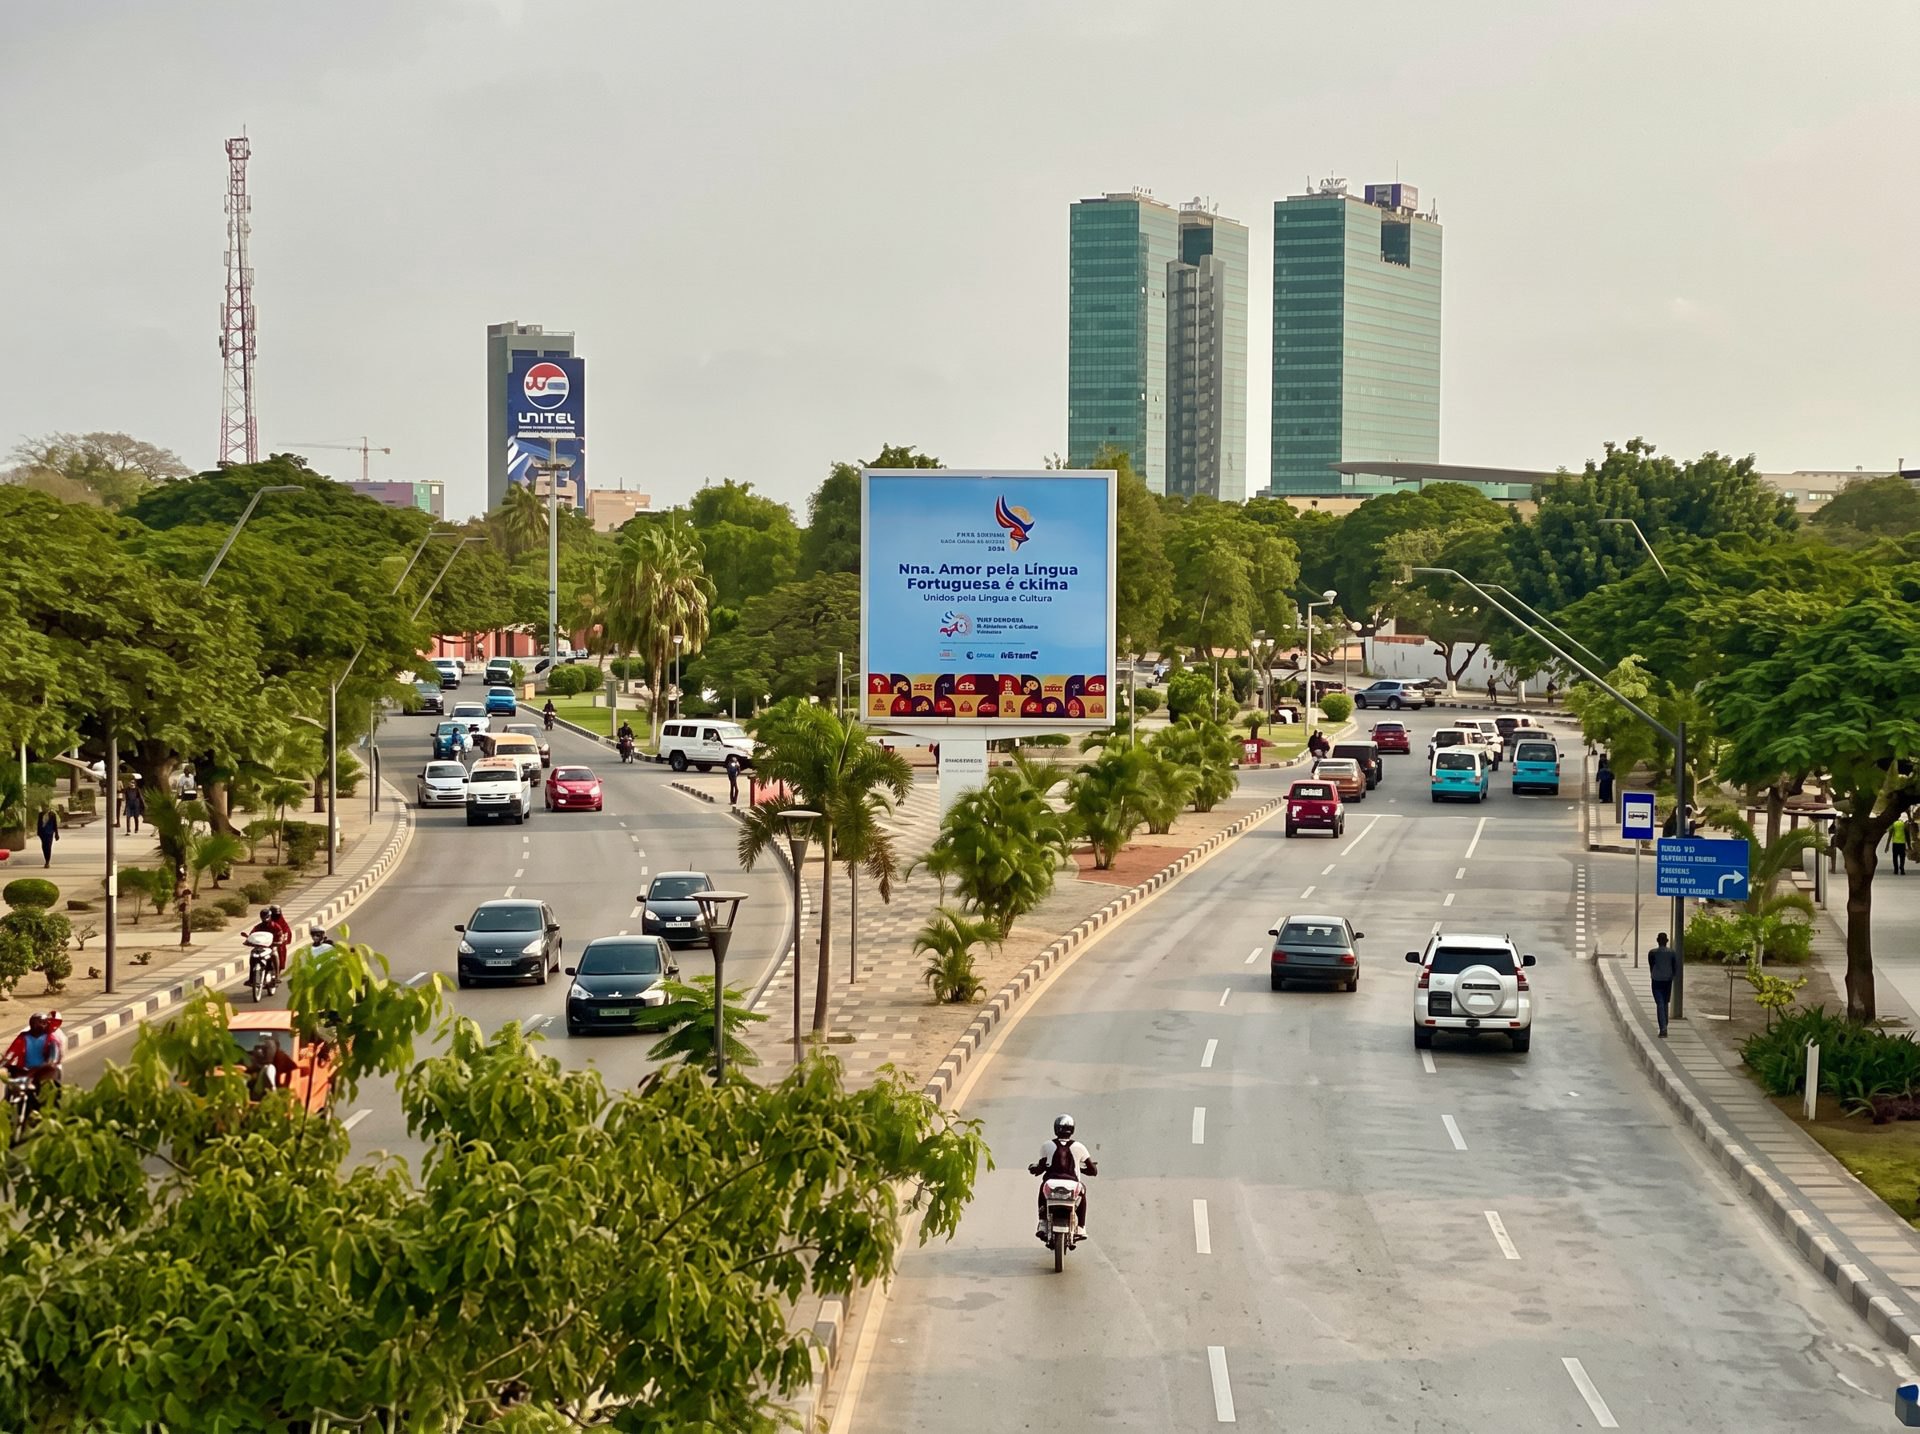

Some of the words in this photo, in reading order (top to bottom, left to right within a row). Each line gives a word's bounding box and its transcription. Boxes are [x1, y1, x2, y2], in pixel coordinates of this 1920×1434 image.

[518, 412, 575, 424] UNITEL
[899, 564, 934, 575] Nna.
[939, 564, 982, 575] Amor
[986, 563, 1020, 577] pela
[1024, 562, 1078, 577] Língua
[1006, 577, 1014, 590] é
[924, 594, 954, 602] Unidos
[958, 594, 976, 603] pela
[978, 594, 1009, 603] Língua
[1019, 594, 1052, 602] Cultura
